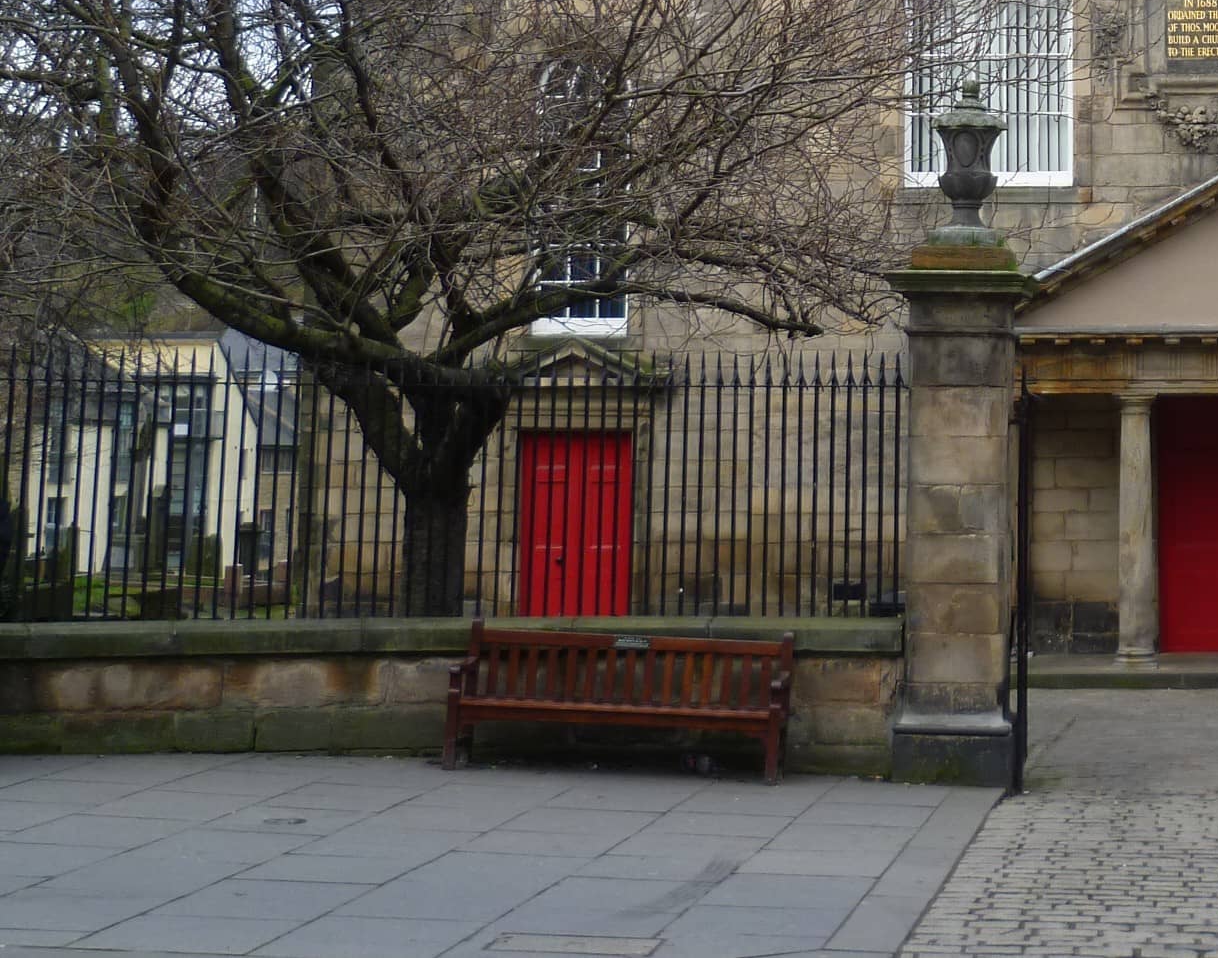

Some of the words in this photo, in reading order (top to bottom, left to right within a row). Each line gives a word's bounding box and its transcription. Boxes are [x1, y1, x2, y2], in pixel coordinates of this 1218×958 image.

[1168, 10, 1206, 20] ORDAINED
[1168, 23, 1179, 32] OF
[1168, 34, 1191, 45] BUILD
[1192, 35, 1200, 44] A
[1167, 47, 1179, 57] TO
[1181, 47, 1196, 57] THE
